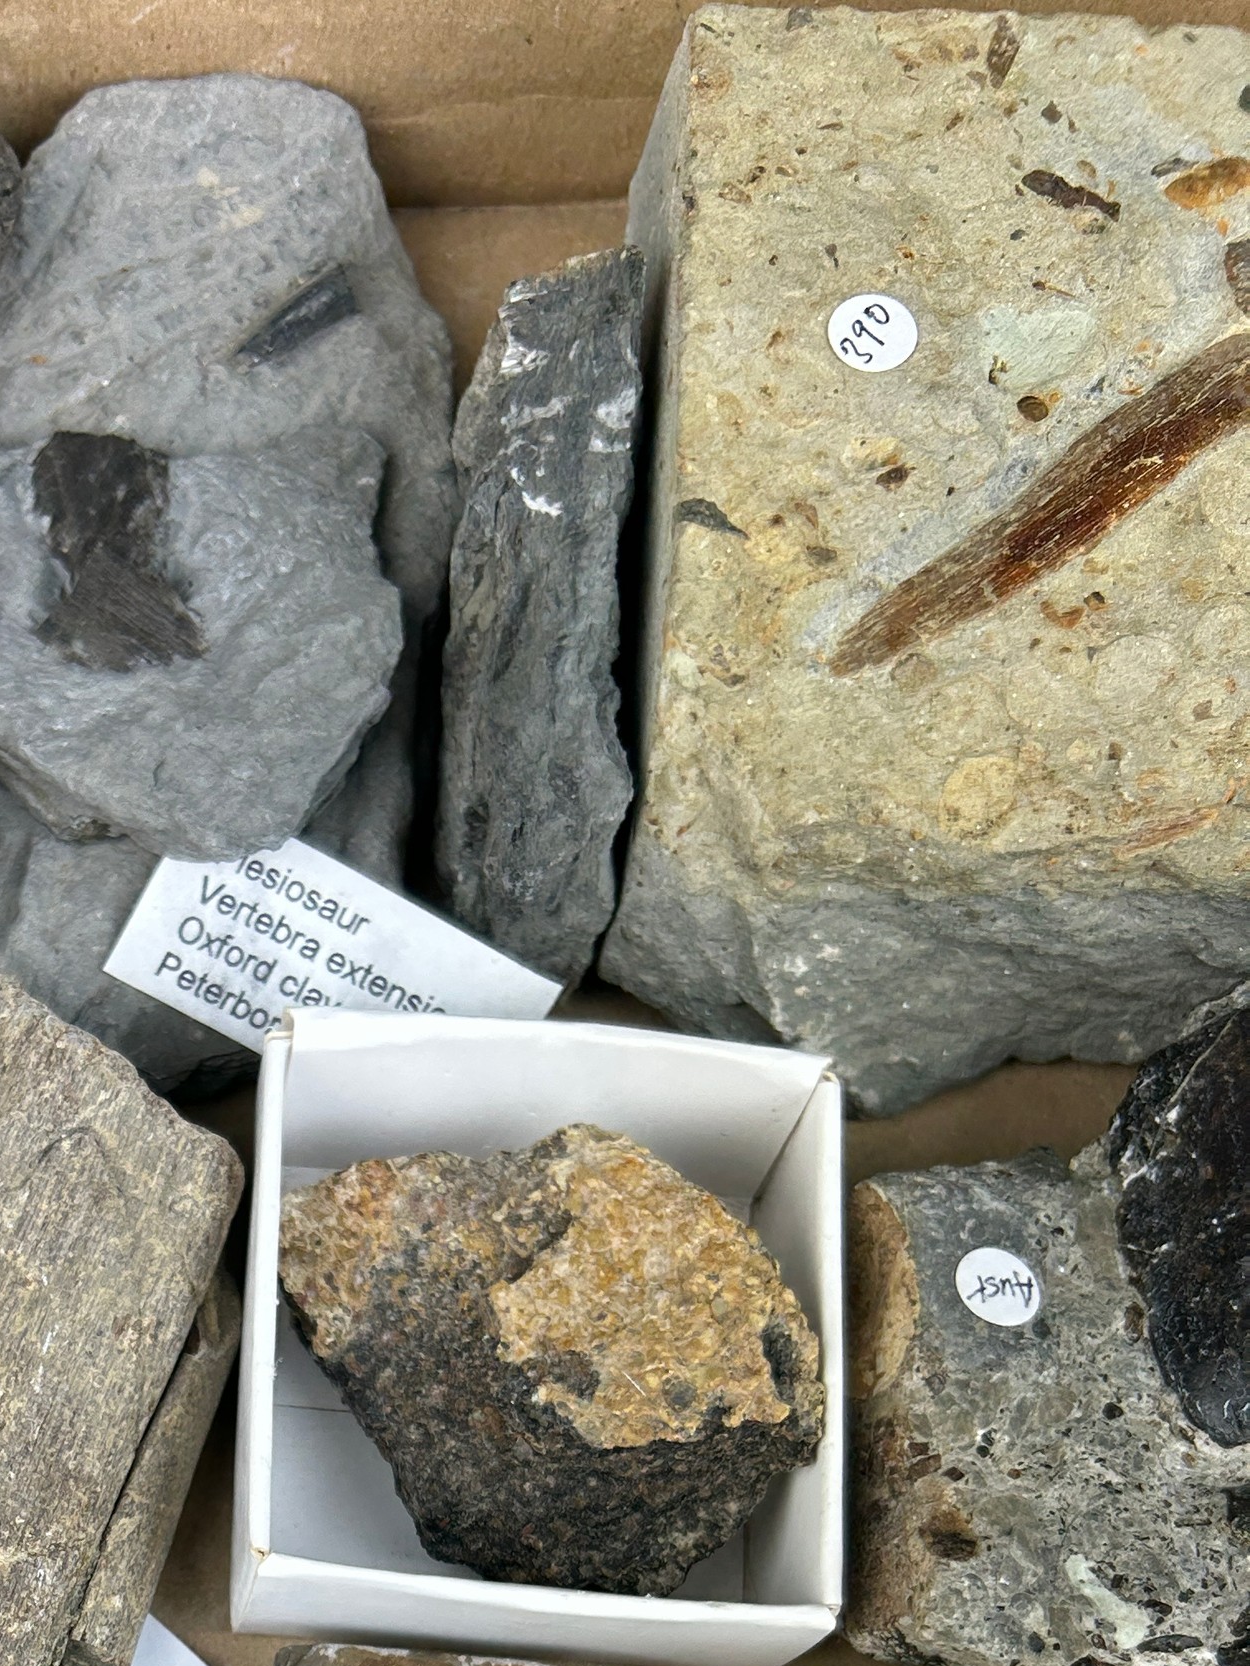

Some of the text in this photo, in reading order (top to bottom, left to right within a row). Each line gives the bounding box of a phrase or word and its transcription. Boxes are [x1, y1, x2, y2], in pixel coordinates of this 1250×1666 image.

[200, 875, 321, 959] Vertebra
[235, 856, 371, 936] lesiosaur
[178, 915, 277, 984] Oxford
[966, 1270, 1034, 1308] Aust
